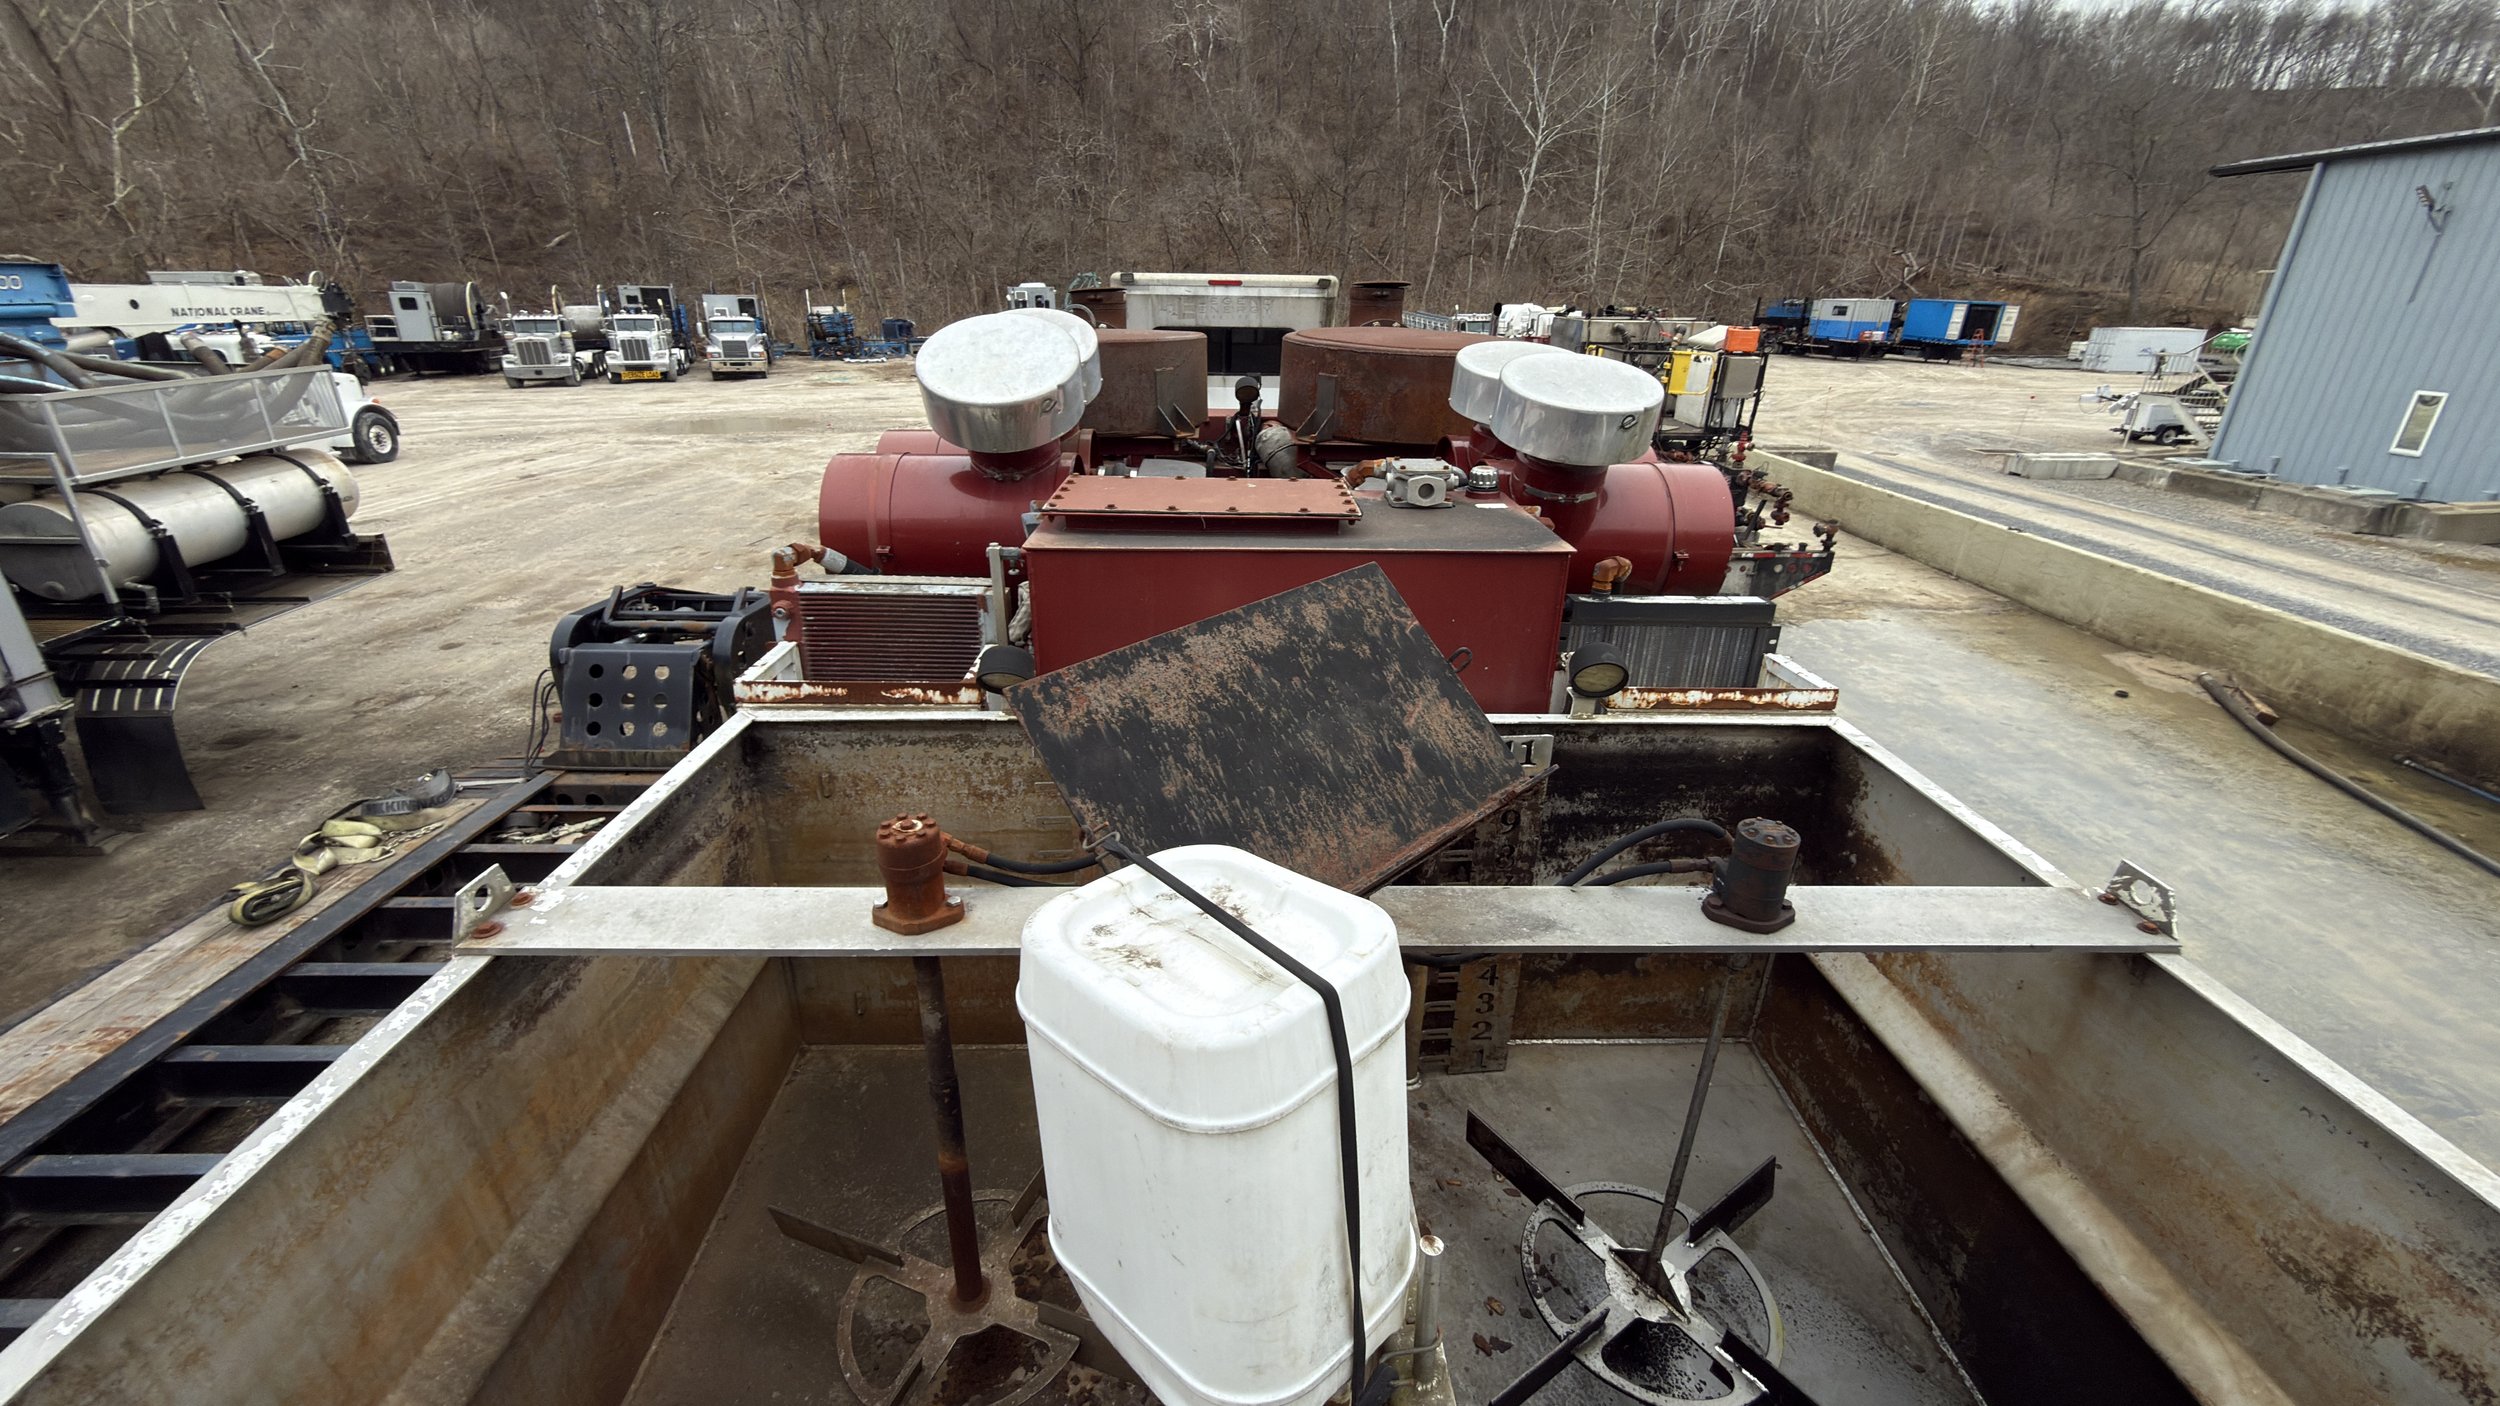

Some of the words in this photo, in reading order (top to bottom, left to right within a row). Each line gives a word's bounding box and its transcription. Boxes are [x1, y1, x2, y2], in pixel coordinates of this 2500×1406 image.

[171, 307, 227, 317] NATIONAL
[229, 306, 264, 316] CRANE
[1477, 964, 1499, 986] 4
[1475, 992, 1495, 1014] 3
[1470, 1021, 1492, 1040] 2
[1471, 1048, 1488, 1069] 1
